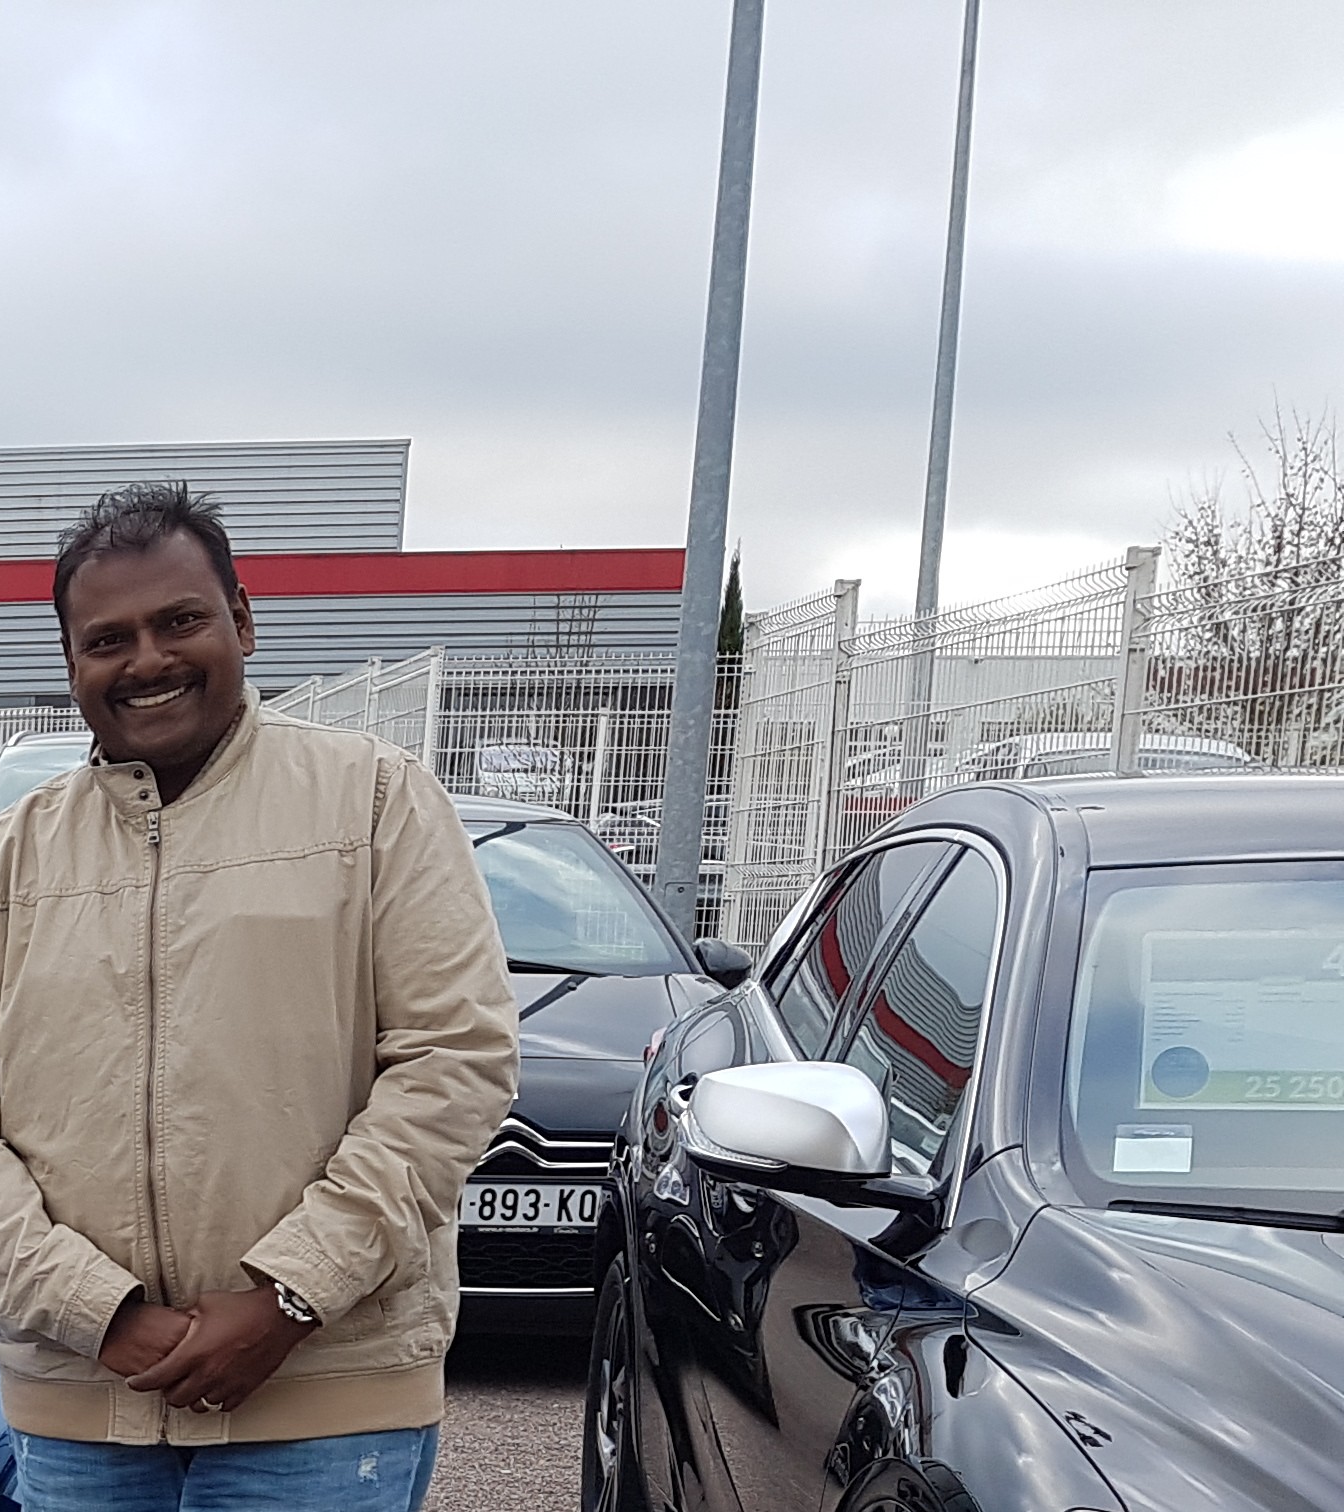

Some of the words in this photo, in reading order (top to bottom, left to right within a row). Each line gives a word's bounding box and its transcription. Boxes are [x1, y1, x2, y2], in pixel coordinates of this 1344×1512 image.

[1245, 1075, 1281, 1099] 25
[1289, 1075, 1344, 1099] 250
[457, 1188, 598, 1223] -893-KQ
